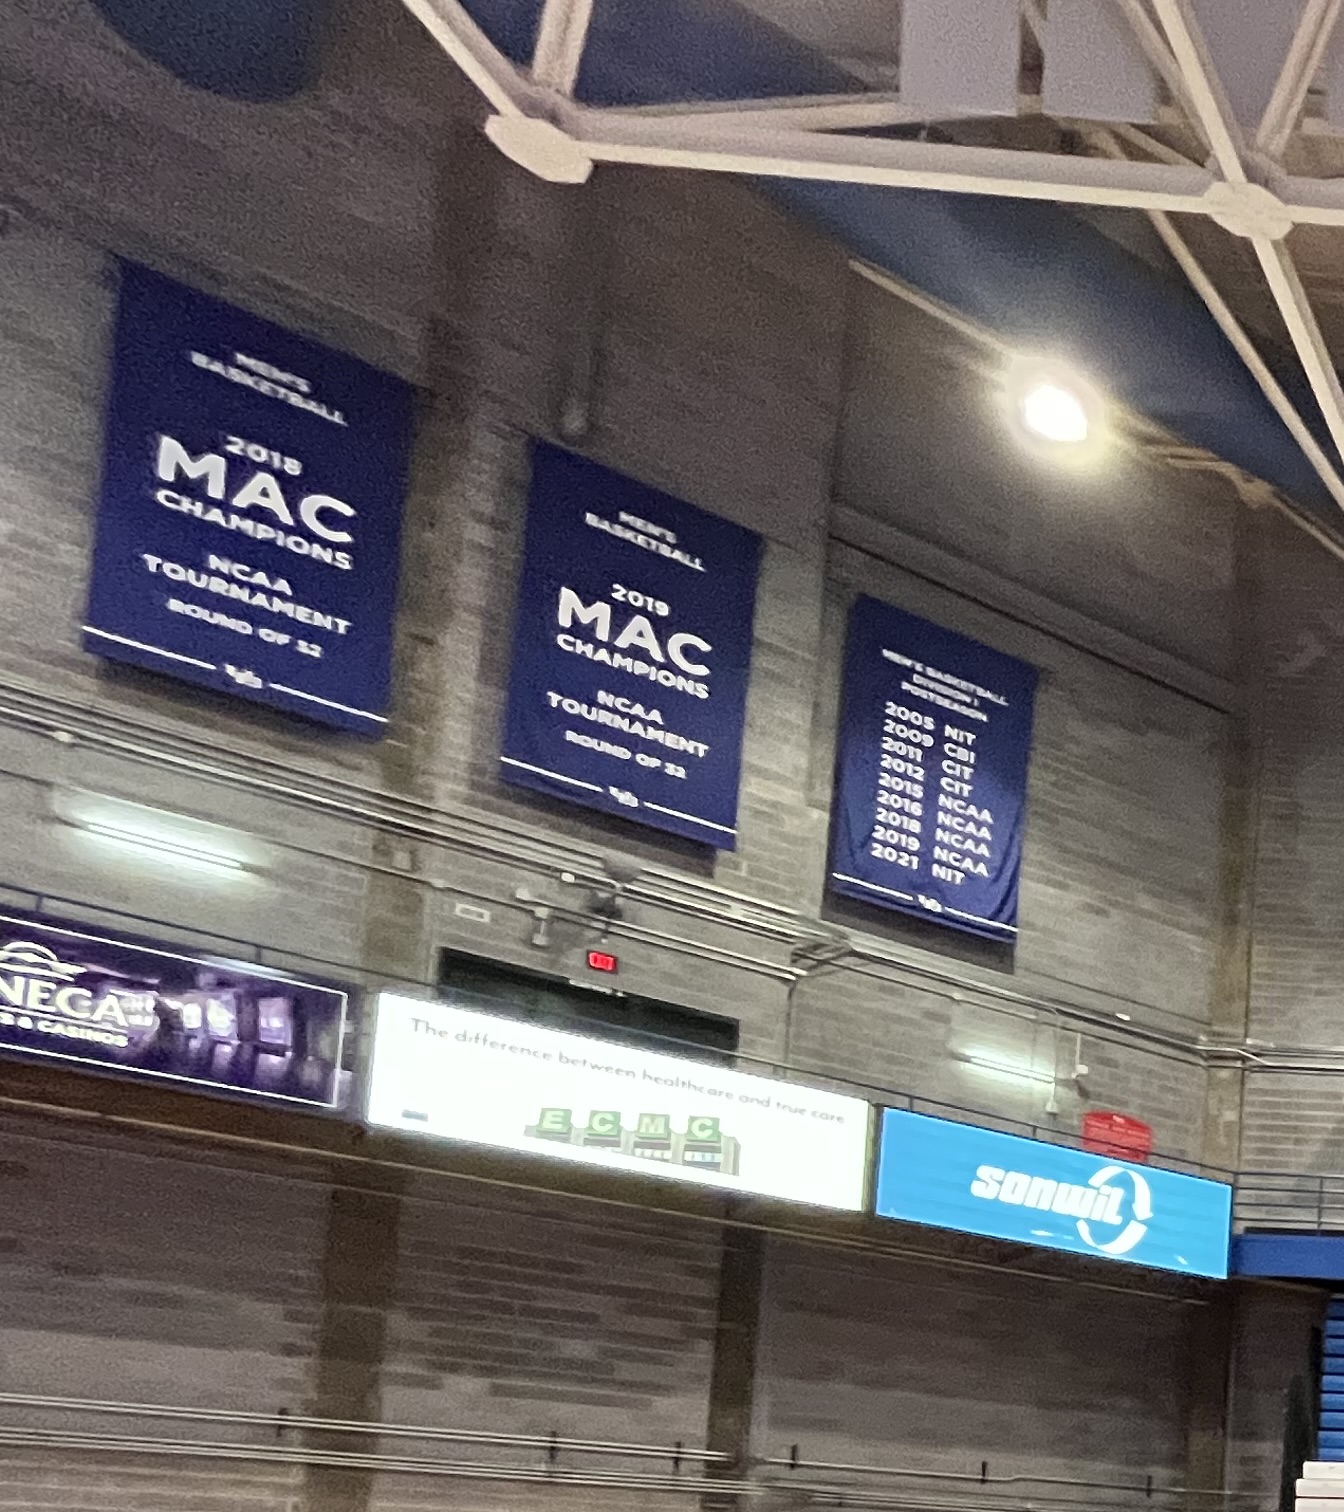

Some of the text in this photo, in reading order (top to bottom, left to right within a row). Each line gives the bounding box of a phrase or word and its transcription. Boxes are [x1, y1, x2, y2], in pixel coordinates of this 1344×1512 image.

[191, 350, 349, 427] BASKETBALL
[223, 434, 302, 476] 2018
[157, 434, 357, 543] MAC
[156, 489, 353, 570] CHAMPIONS
[585, 511, 707, 572] BASKETBALL
[142, 553, 353, 635] TOURNAMENT
[208, 554, 293, 596] NCAA
[611, 583, 670, 617] 2019
[167, 599, 253, 635] ROUND
[258, 628, 292, 645] OF
[558, 586, 713, 677] MAC
[557, 634, 709, 699] CHAMPIONS
[546, 691, 710, 758] TOURNAMENT
[597, 690, 664, 726] NCAA
[884, 701, 976, 745] 2005 NIT
[565, 730, 632, 760] ROUND
[635, 753, 662, 769] OF
[881, 736, 974, 780] 2011 CIT
[878, 772, 994, 824] 2015 NCAA
[880, 754, 974, 797] 2012 CIT
[876, 807, 990, 858] 2018 NCAA
[877, 790, 992, 841] 2016 NCAA
[871, 843, 966, 885] 2021 NIT
[872, 825, 989, 878] 2019 NCAA
[37, 1020, 129, 1047] CASINOS
[410, 1017, 845, 1124] The difference between healthcare and true care
